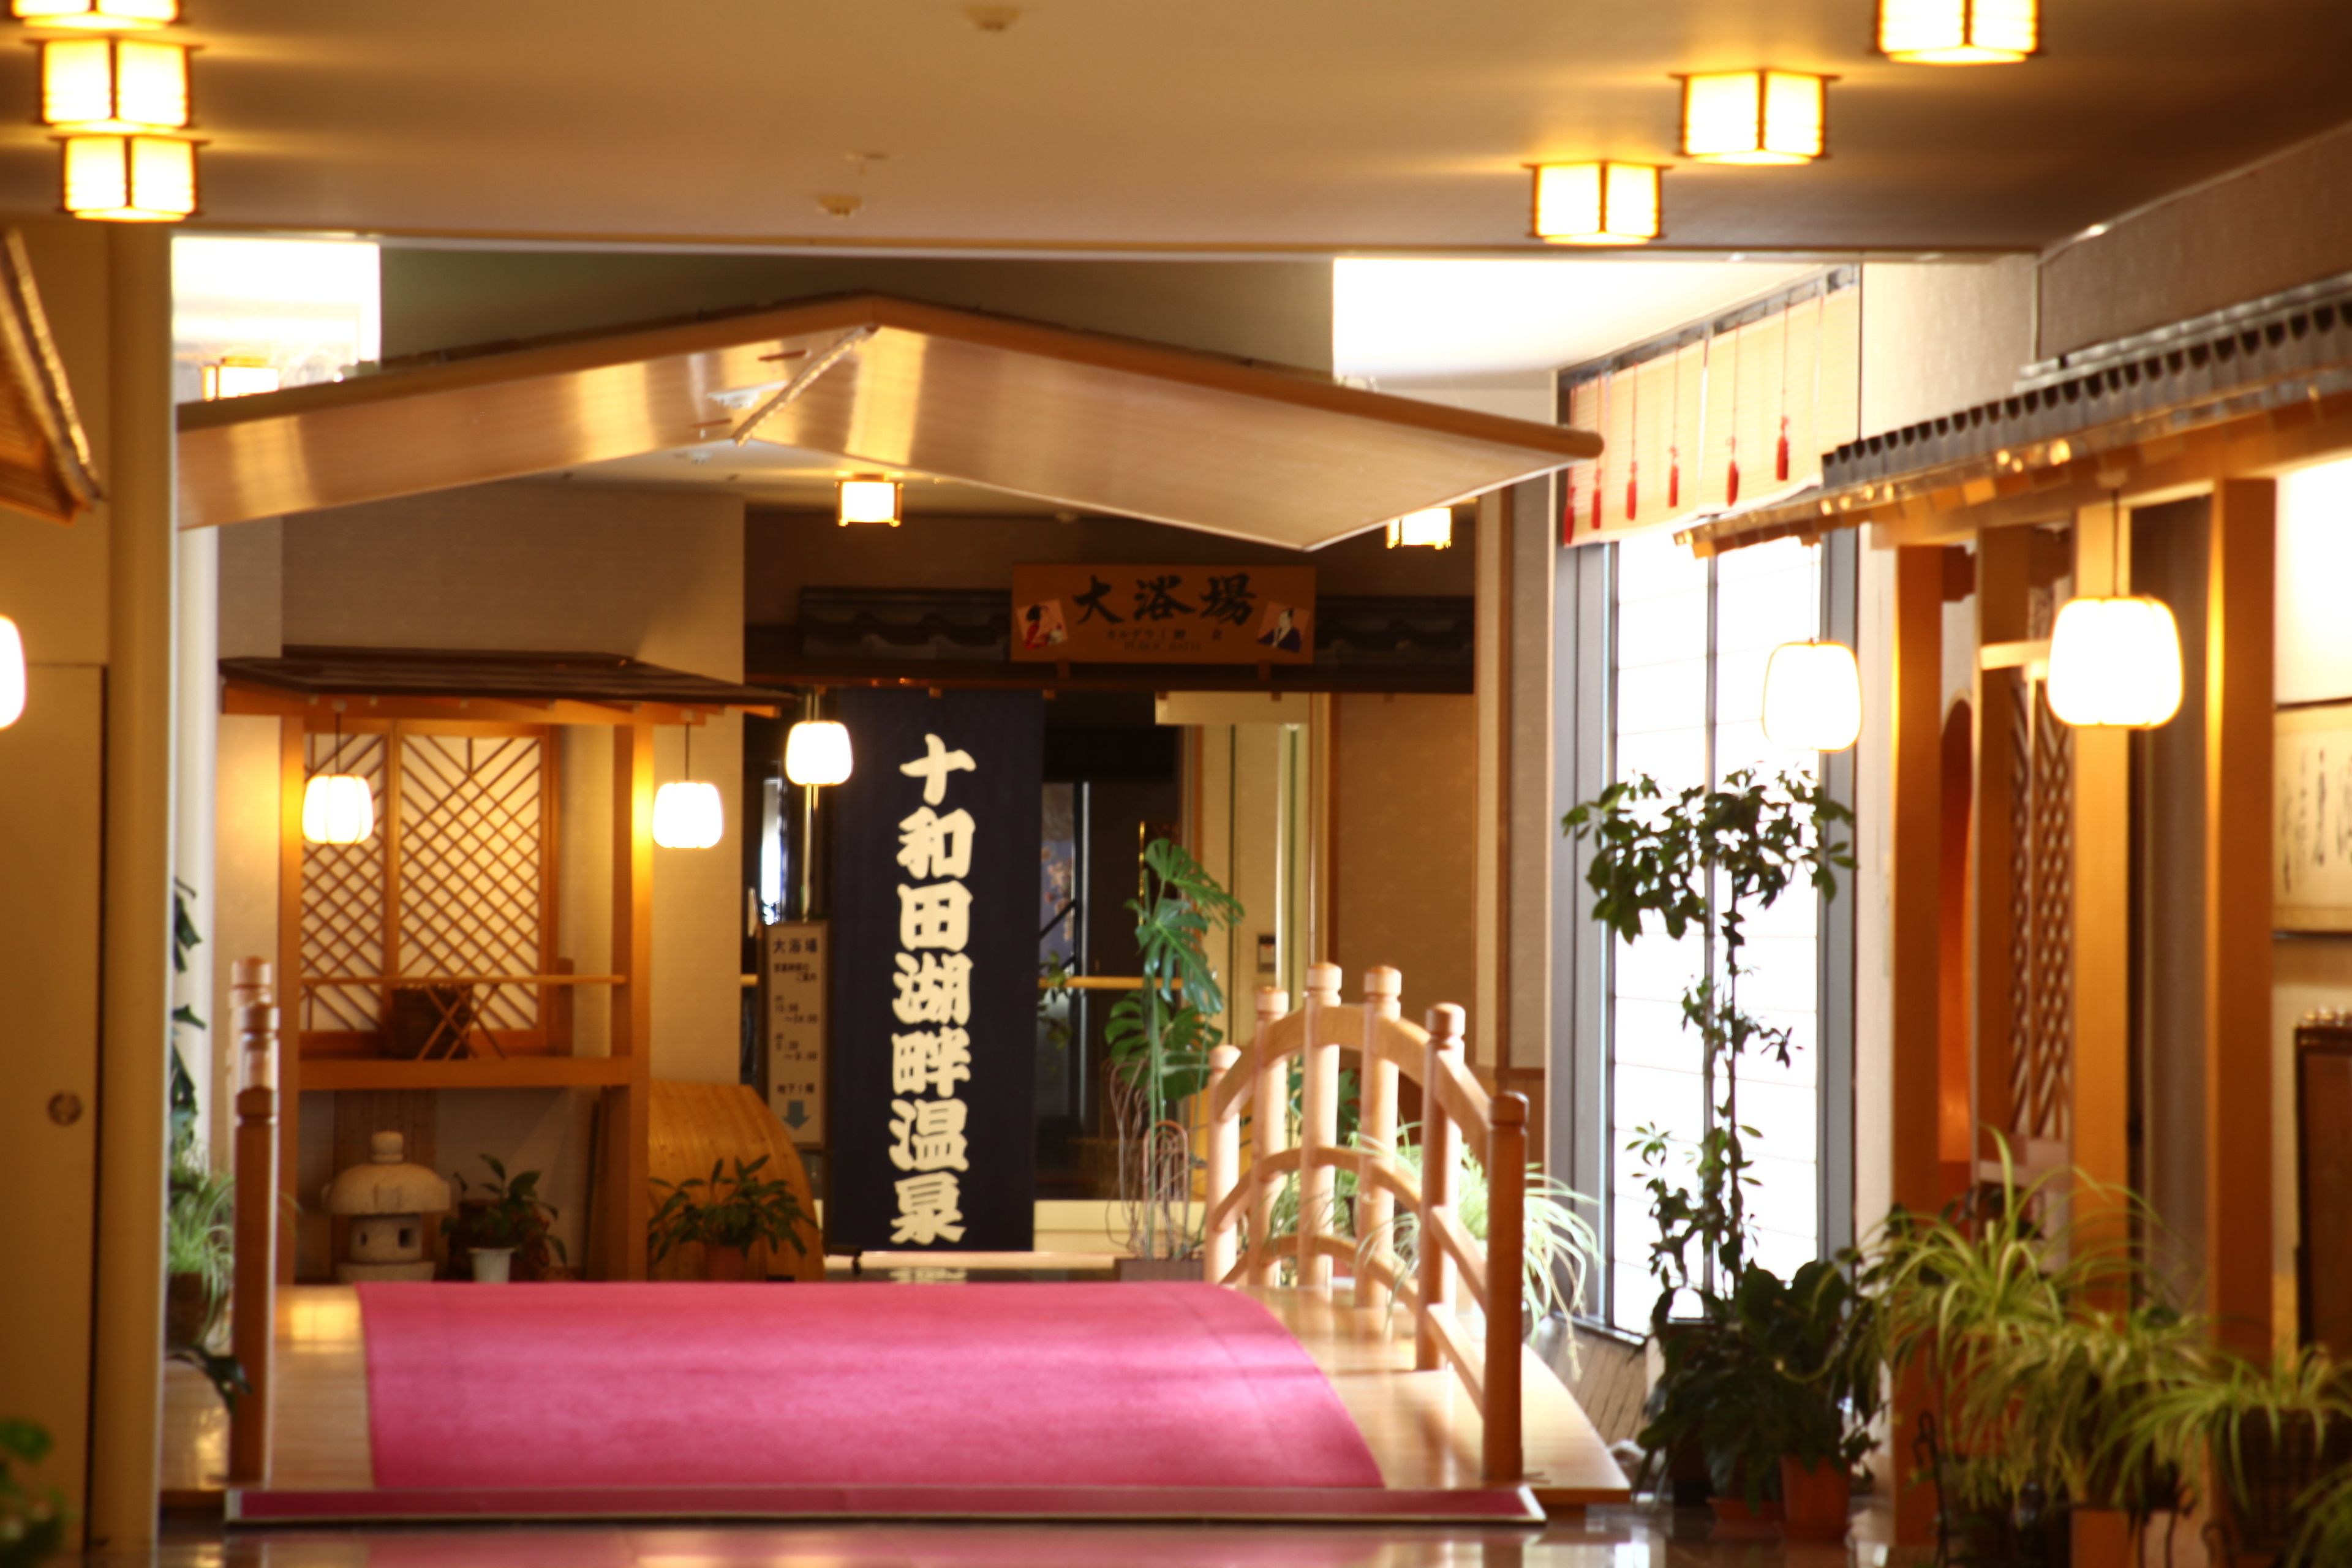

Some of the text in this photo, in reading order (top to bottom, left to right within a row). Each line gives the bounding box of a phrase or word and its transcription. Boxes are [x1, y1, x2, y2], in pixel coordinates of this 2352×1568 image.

[1072, 573, 1256, 626] 大浴場
[889, 733, 976, 1246] 十和田湖畔温泉
